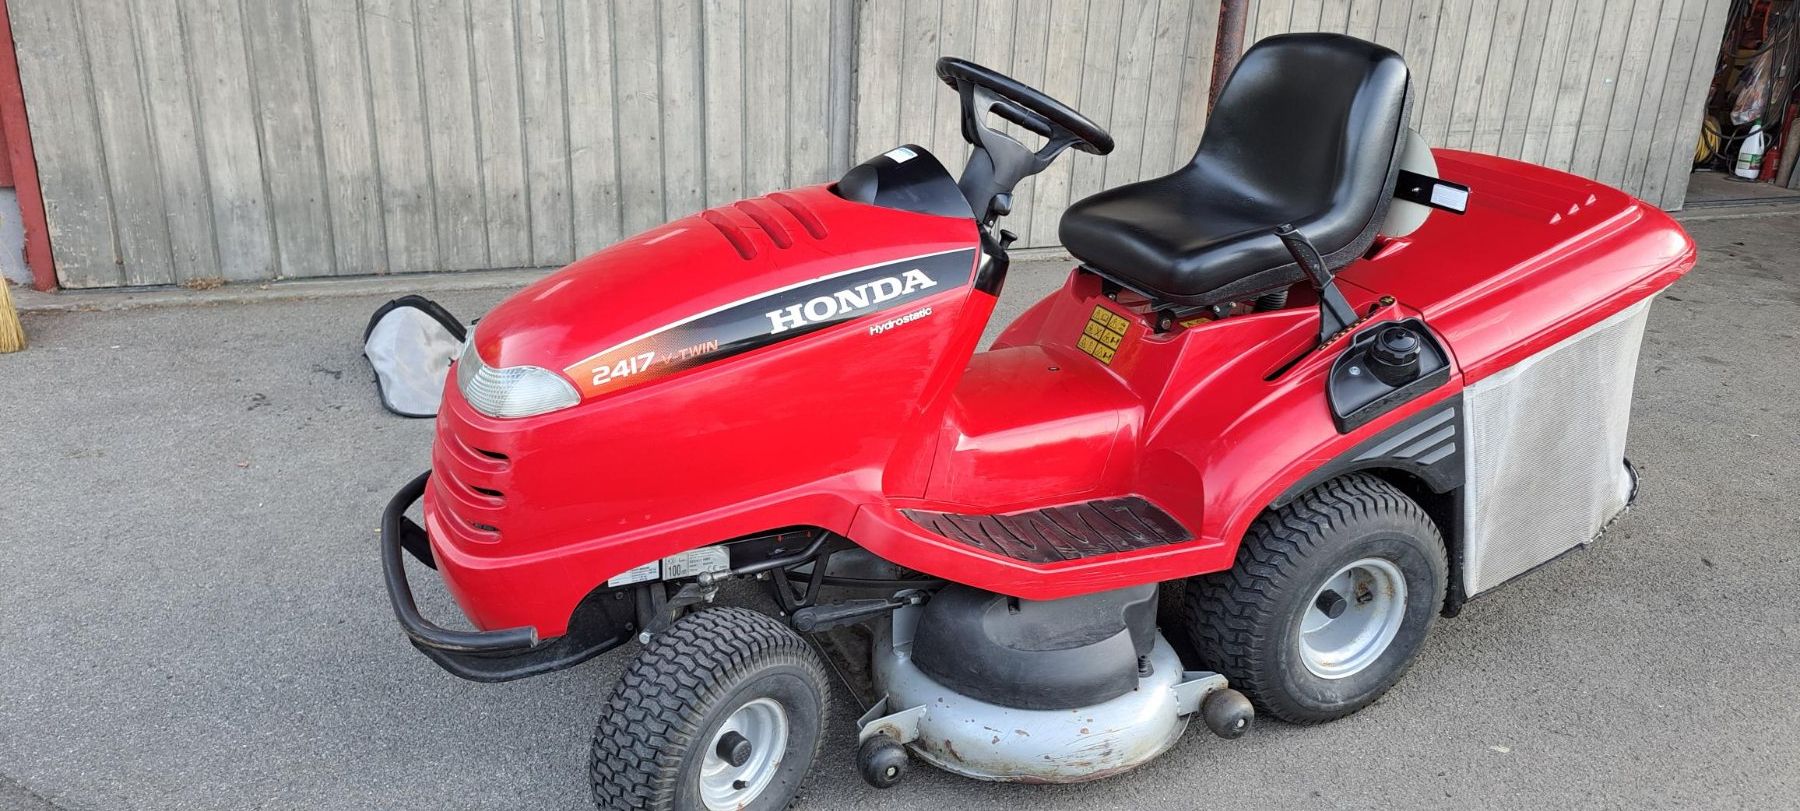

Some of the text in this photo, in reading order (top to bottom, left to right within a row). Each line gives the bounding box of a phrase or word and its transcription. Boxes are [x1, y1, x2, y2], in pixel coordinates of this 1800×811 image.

[766, 268, 938, 335] HONDA
[869, 307, 933, 336] Hydrostatic
[592, 339, 719, 386] 2417 V-TWIN
[668, 564, 681, 577] 100
